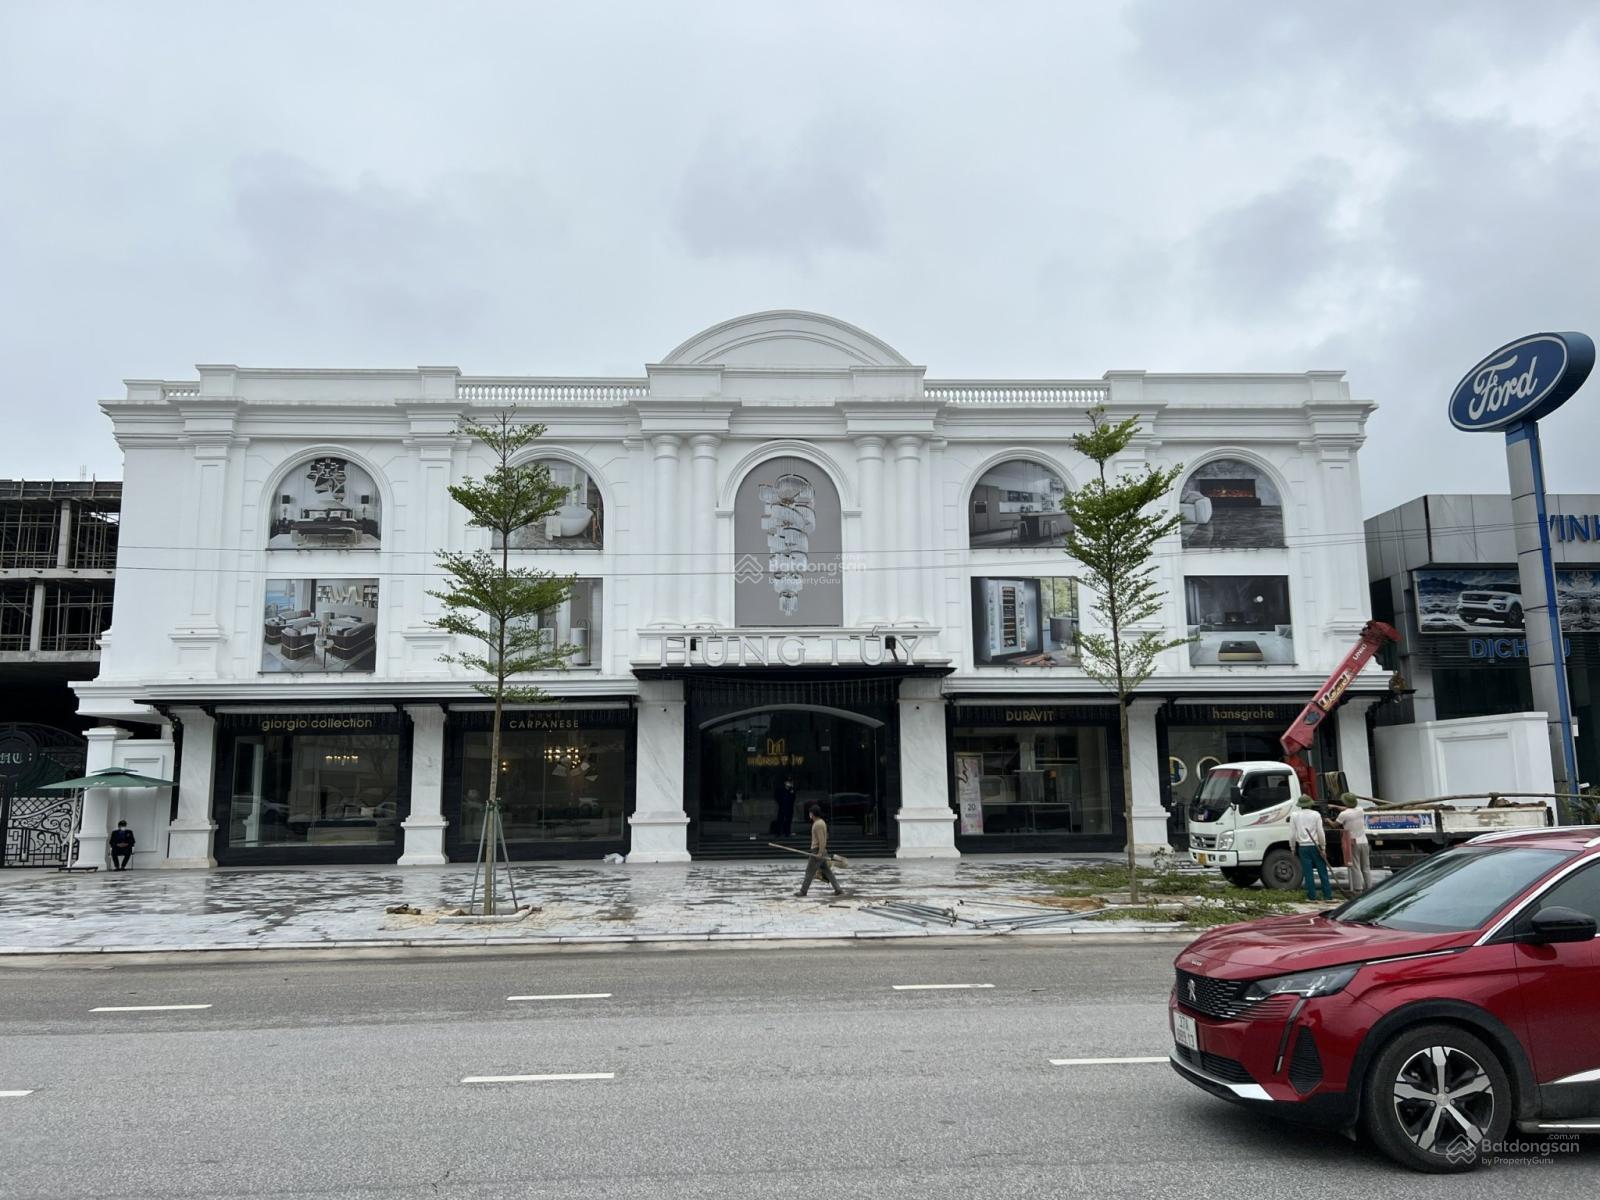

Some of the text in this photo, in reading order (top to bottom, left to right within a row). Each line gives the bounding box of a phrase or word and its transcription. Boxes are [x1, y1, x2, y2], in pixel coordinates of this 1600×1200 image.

[1468, 354, 1537, 420] Ford
[1006, 707, 1055, 721] DURAVIT
[1212, 703, 1274, 720] hansgrohe
[262, 718, 373, 732] giorgio collection
[509, 719, 579, 729] CARPANESE
